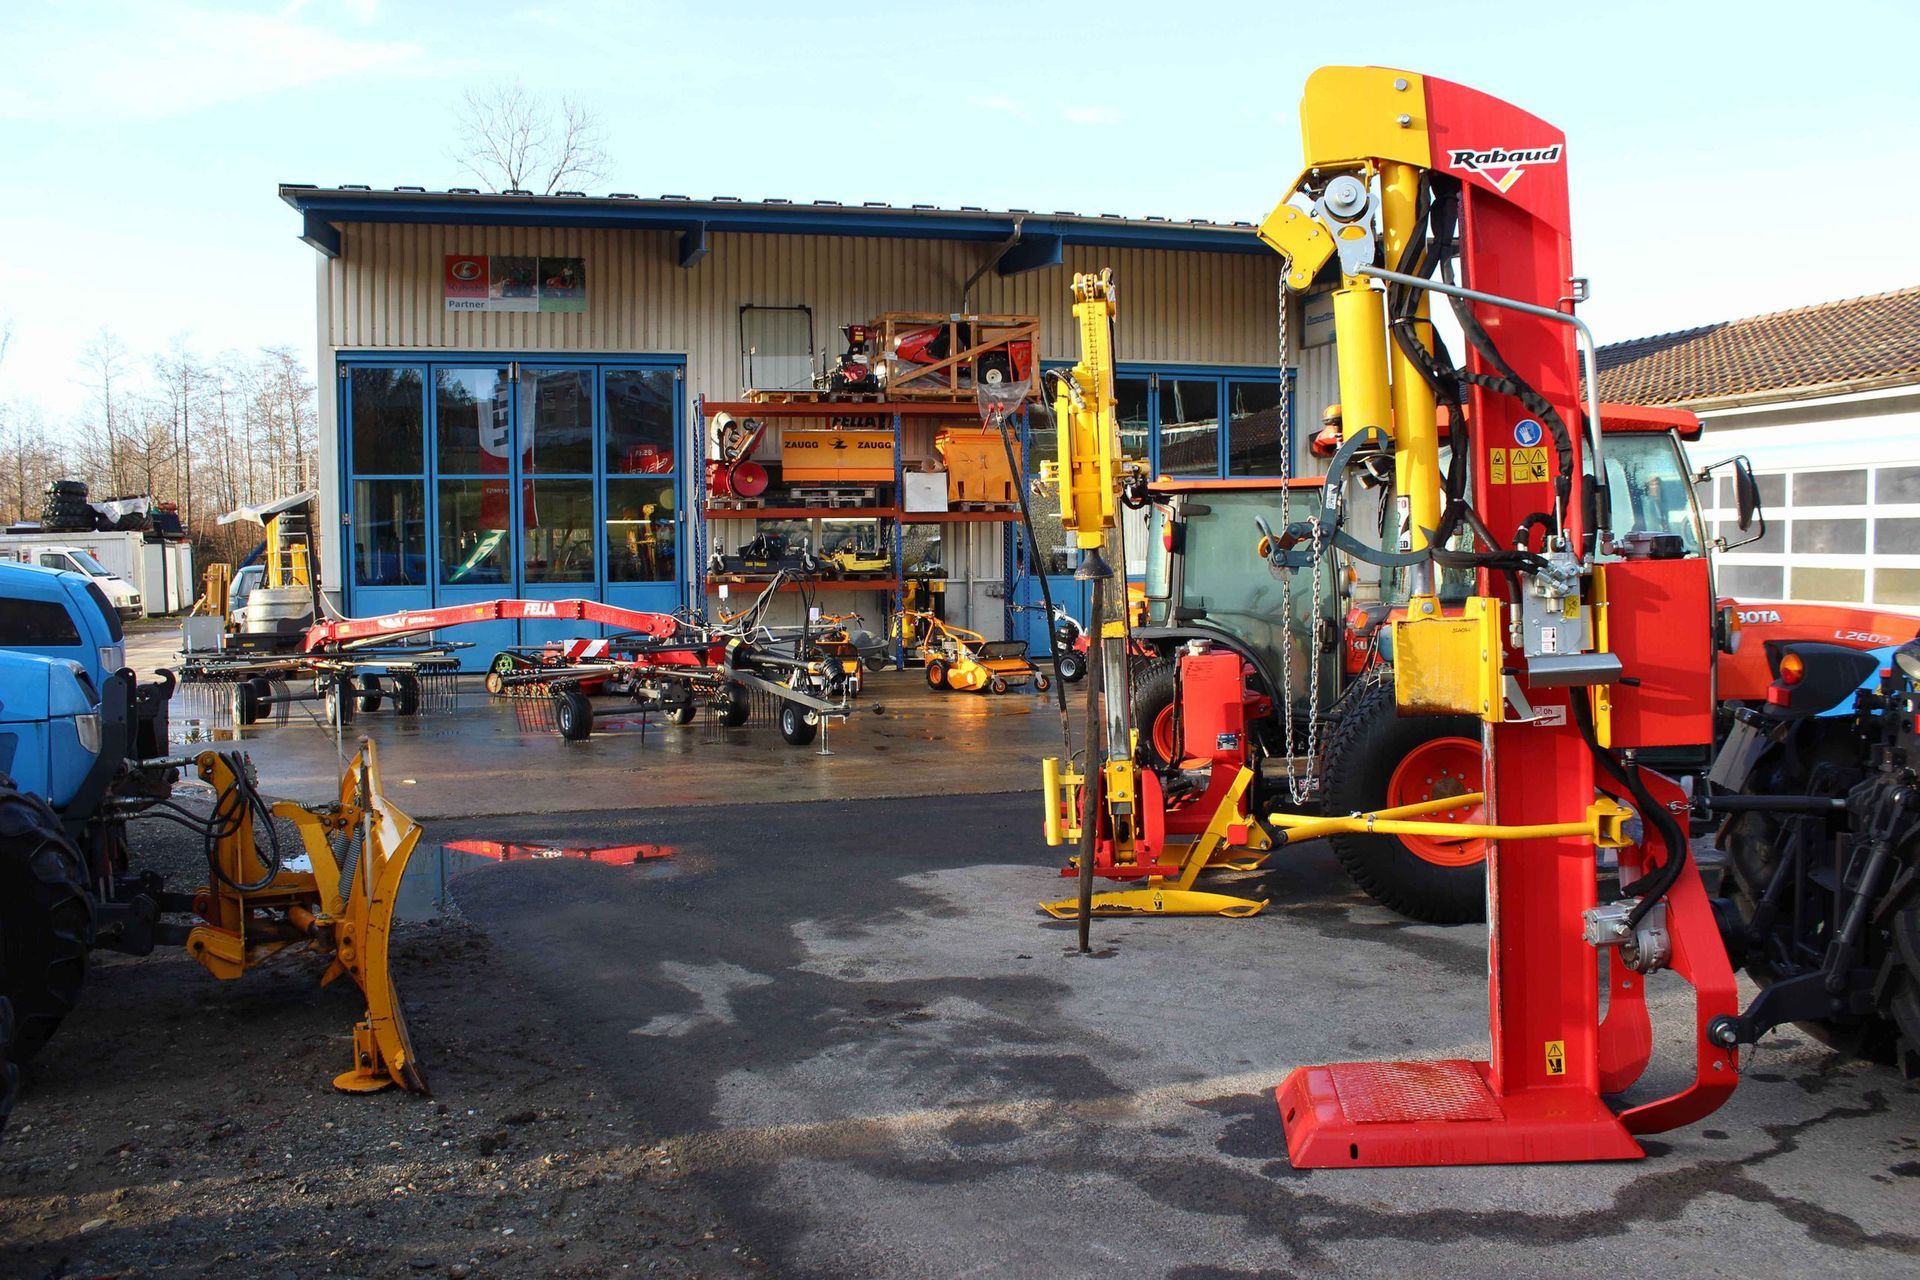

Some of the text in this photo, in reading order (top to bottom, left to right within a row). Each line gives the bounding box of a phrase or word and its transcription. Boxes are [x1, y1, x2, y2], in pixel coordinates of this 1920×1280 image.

[1453, 147, 1559, 169] Rabaud
[449, 300, 485, 309] Partner
[784, 440, 819, 449] ZAUGG
[857, 441, 892, 449] ZAUGG
[523, 602, 556, 616] FELLA
